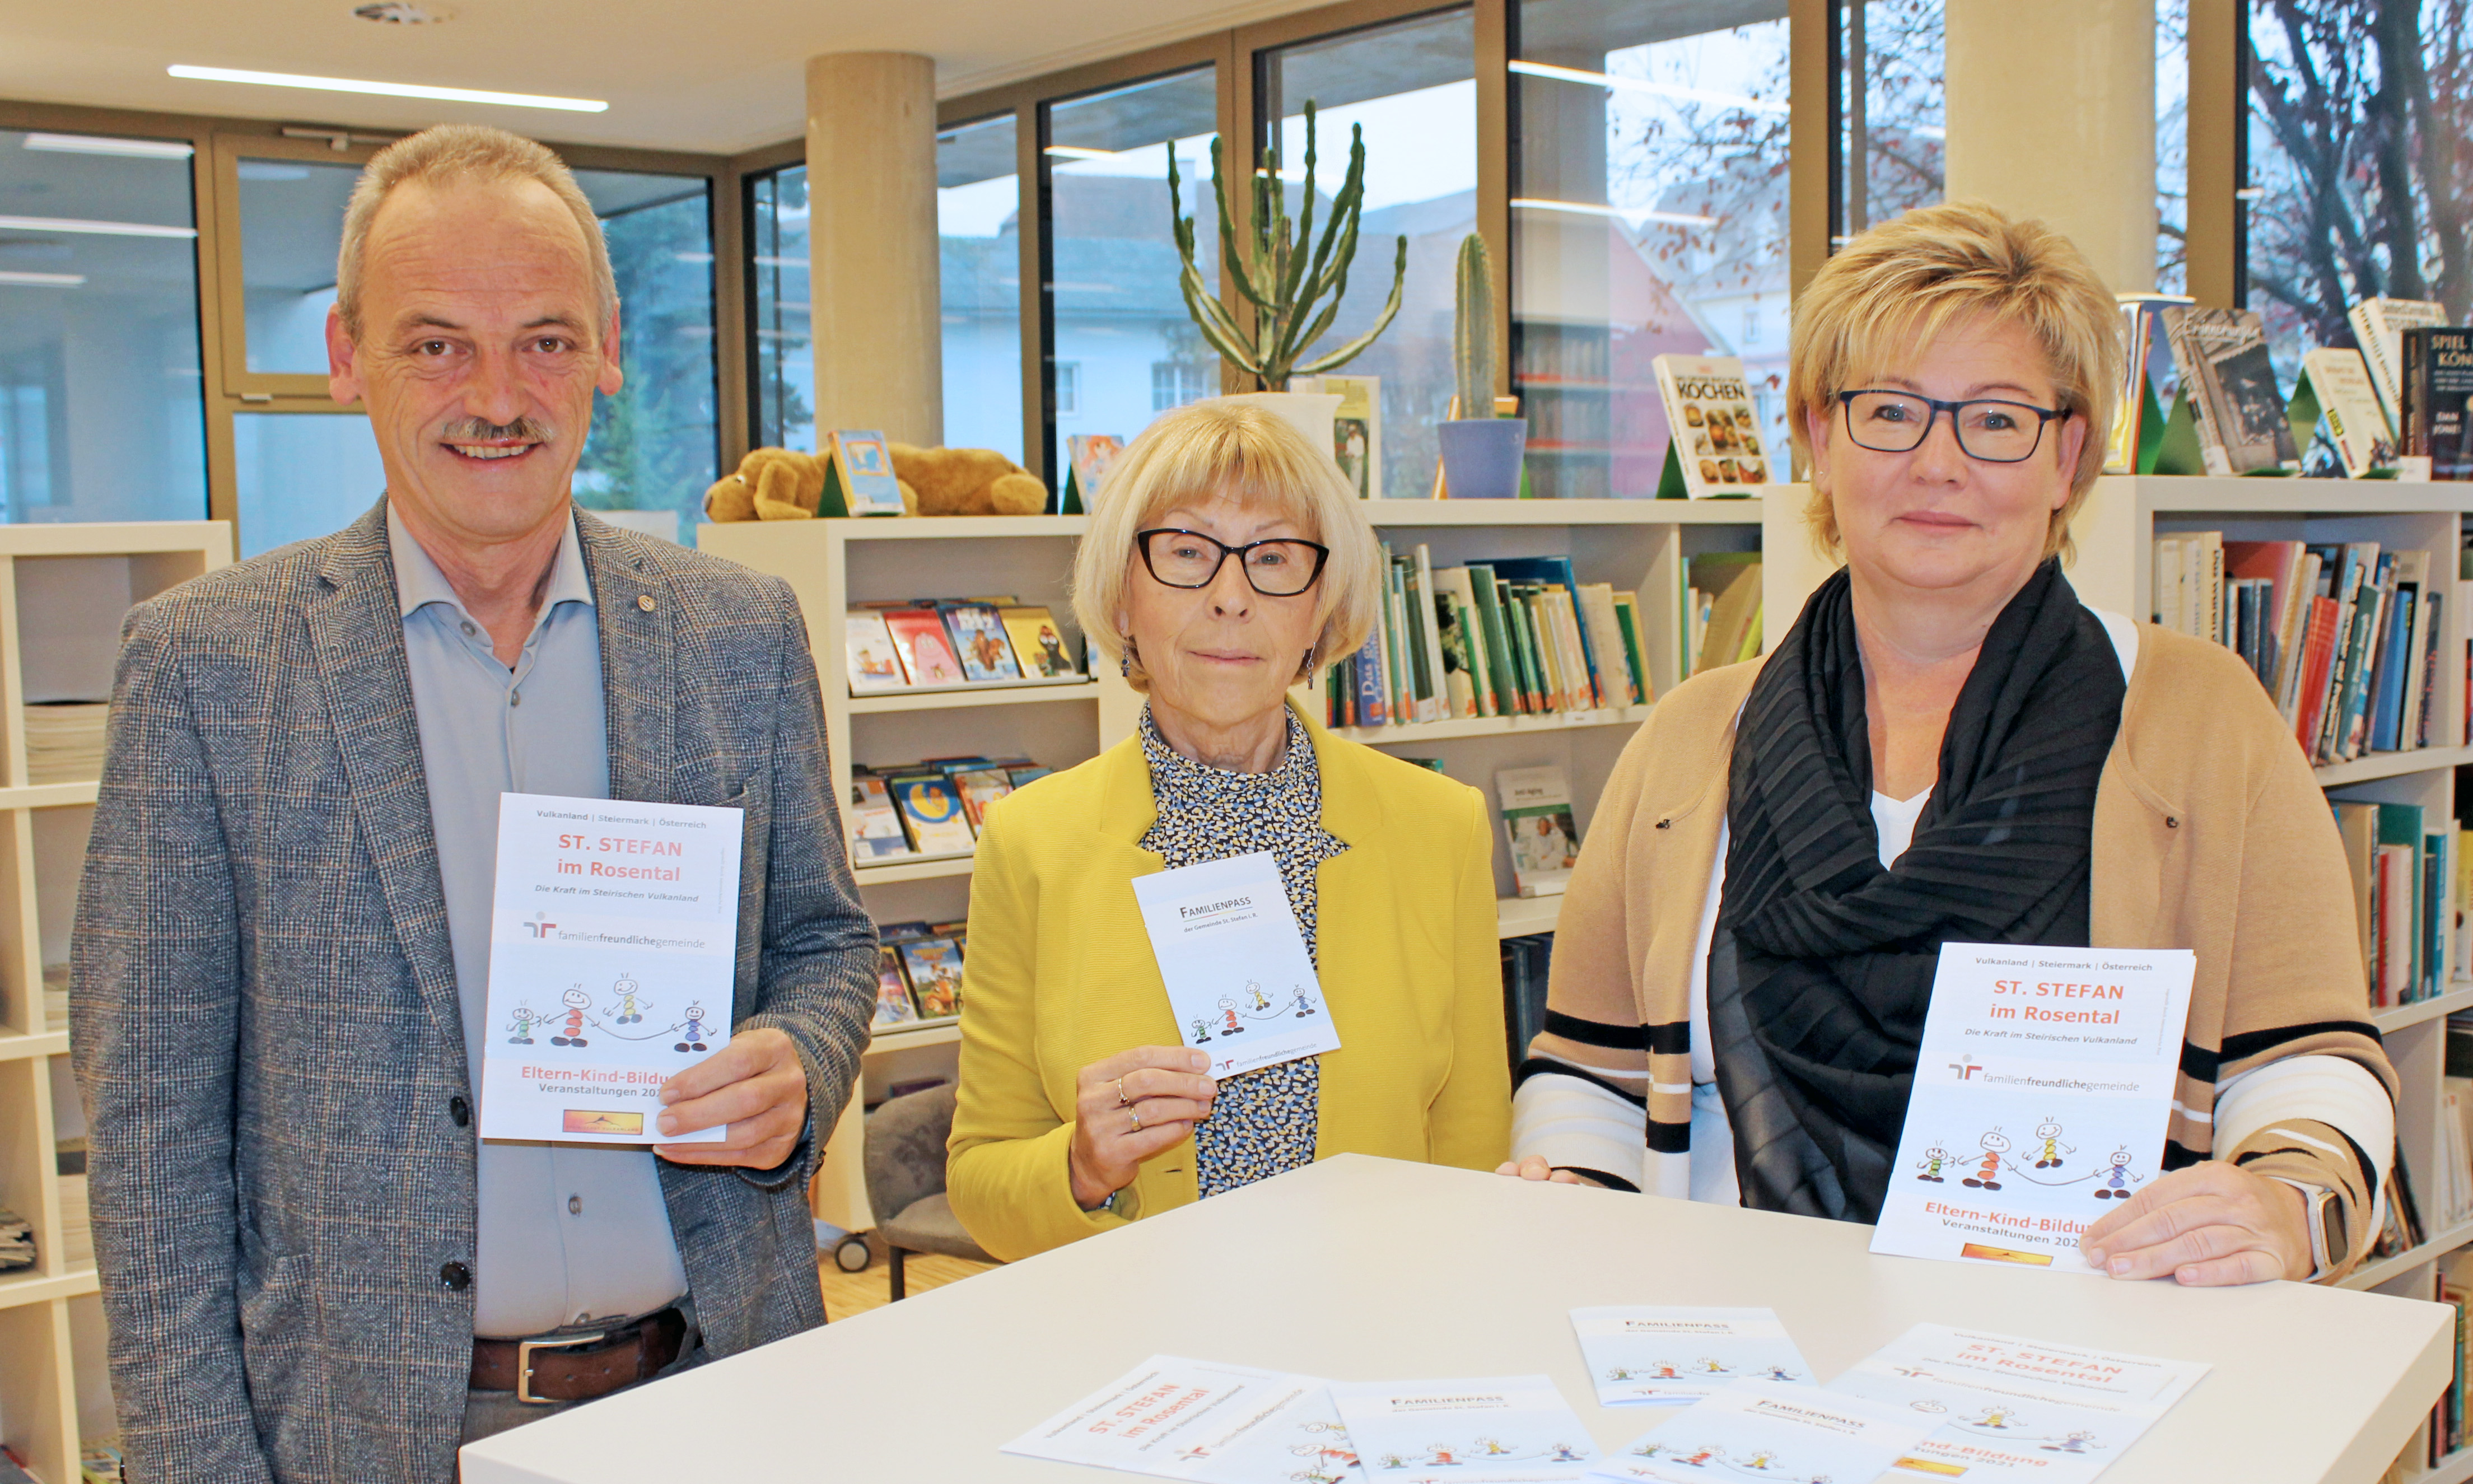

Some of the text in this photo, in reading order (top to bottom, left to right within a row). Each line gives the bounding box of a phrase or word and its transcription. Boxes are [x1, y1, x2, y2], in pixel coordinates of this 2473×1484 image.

[1677, 383, 1746, 400] KOCHEN
[1362, 664, 1375, 696] Das
[536, 810, 588, 821] Vulkanland
[598, 814, 649, 825] Steiermark
[659, 818, 707, 829] Österreich
[558, 834, 682, 856] ST. STEFAN
[557, 859, 680, 881] im Rosental
[535, 885, 550, 893] Die
[553, 886, 576, 895] Kraft
[593, 888, 644, 899] Steirischen
[648, 891, 699, 903] Vulkanland
[1180, 897, 1251, 918] FAMILIENPASS
[1194, 921, 1222, 930] Gemeinde
[558, 931, 706, 949] familienfreundlichegemeinde
[1976, 957, 2028, 967] Vulkanland
[2038, 960, 2091, 970] Steiermark
[2102, 962, 2152, 972] Österreich
[1994, 981, 2124, 999] ST. STEFAN
[1990, 1005, 2120, 1024] im Rosental
[1984, 1030, 2007, 1039] Kraft
[2024, 1033, 2079, 1042] Steirischen
[2083, 1036, 2138, 1045] Vulkanland
[1236, 1043, 1317, 1067] familienfreundlichegemeinde
[521, 1066, 669, 1085] Eltern-Kind-Bildu
[1983, 1073, 2139, 1093] familienfreundlichegemeinde
[539, 1083, 637, 1098] Veranstaltungen
[1925, 1201, 2092, 1234] Eltern-Kind-Bildu
[1942, 1219, 2079, 1248] Veranstaltungen 202
[1954, 1332, 2014, 1345] Vulkanland
[2027, 1345, 2088, 1358] Steiermark
[2101, 1356, 2162, 1368] Österreich
[1968, 1344, 2123, 1375] ST. STEFAN
[1944, 1360, 1976, 1370] Kraft
[1957, 1352, 2113, 1384] im Rosental
[1089, 1384, 1180, 1434] ST. STEFAN
[1392, 1397, 1504, 1405] FAMILIENPASS
[1117, 1388, 1210, 1439] im Rosental
[1757, 1400, 1866, 1428] FAMILIENPASS
[1922, 1441, 2049, 1467] nd-Bildung
[1975, 1457, 2015, 1468] 2021
